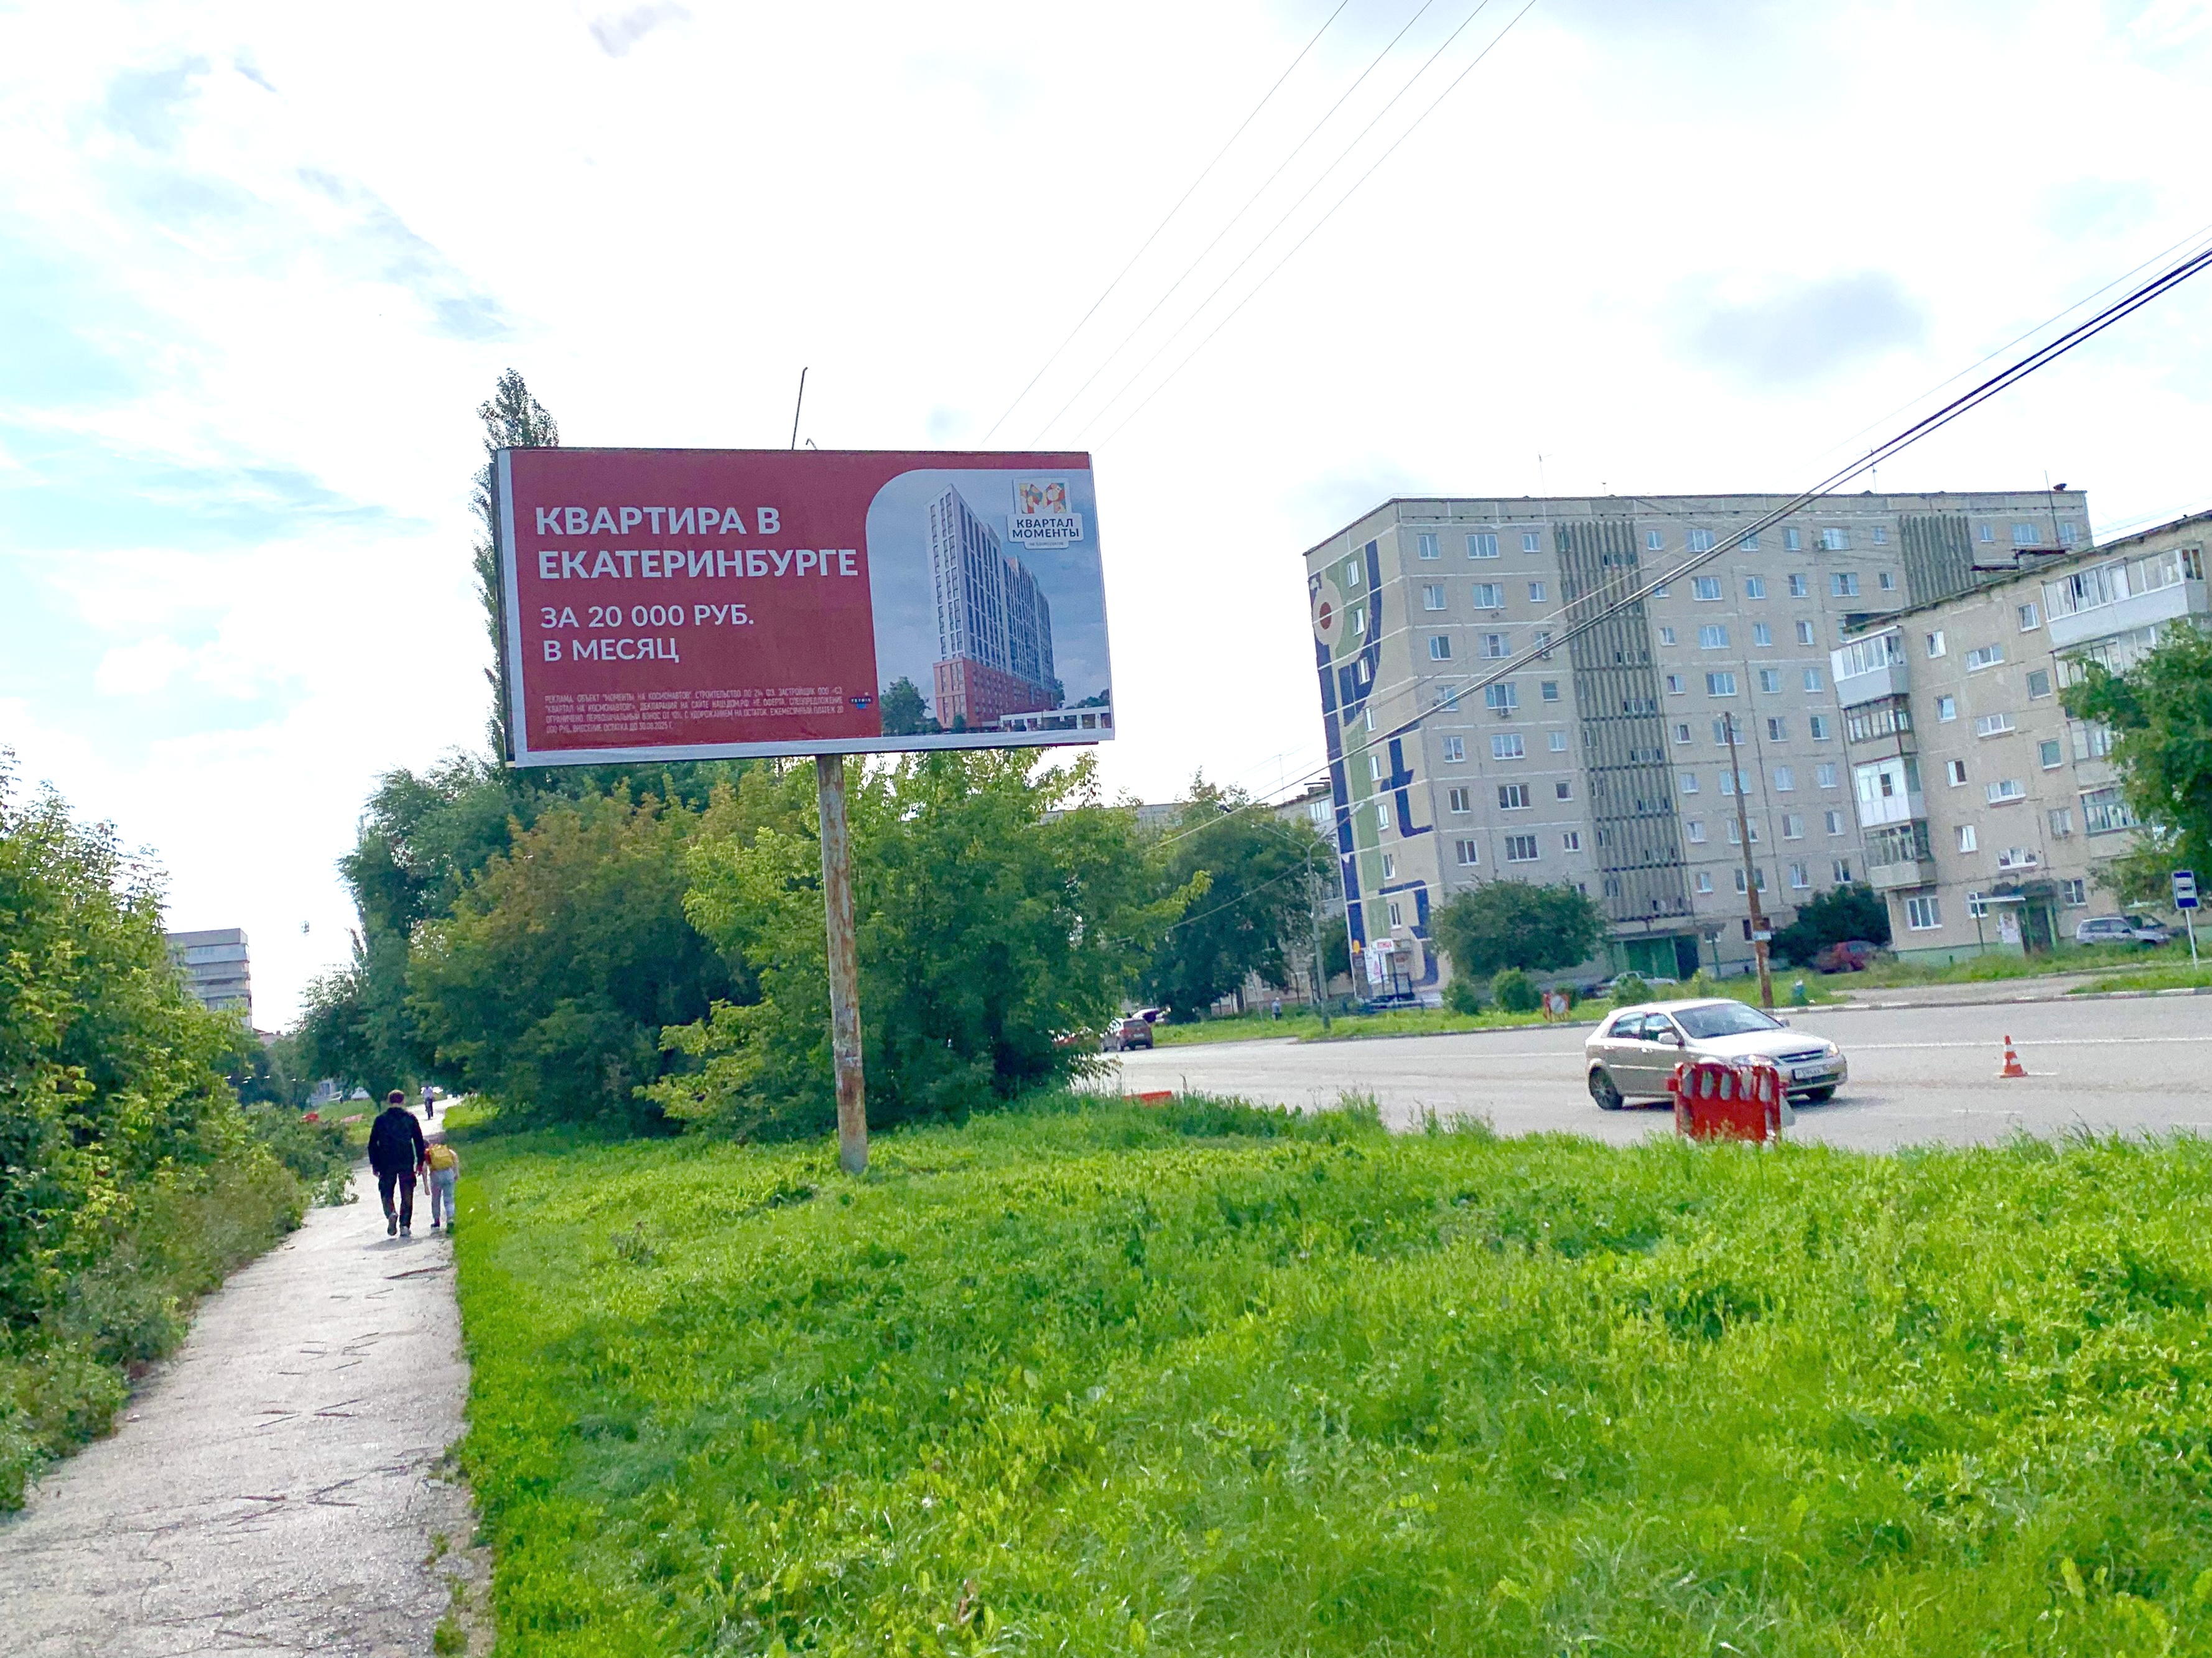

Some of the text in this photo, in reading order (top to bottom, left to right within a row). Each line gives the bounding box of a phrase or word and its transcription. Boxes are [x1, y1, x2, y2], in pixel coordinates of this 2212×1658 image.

[536, 507, 781, 535] КВАРТИРА В
[1012, 528, 1079, 538] МОМЕНТЫ
[1016, 518, 1074, 528] КВАРТАЛ
[538, 549, 858, 578] ЕКАТЕРИНБУРГЕ
[541, 604, 754, 628] ЗА 20 000 РУБ.
[543, 637, 679, 664] В МЕСЯЦ
[637, 692, 645, 701] НА
[744, 689, 752, 697] ПО
